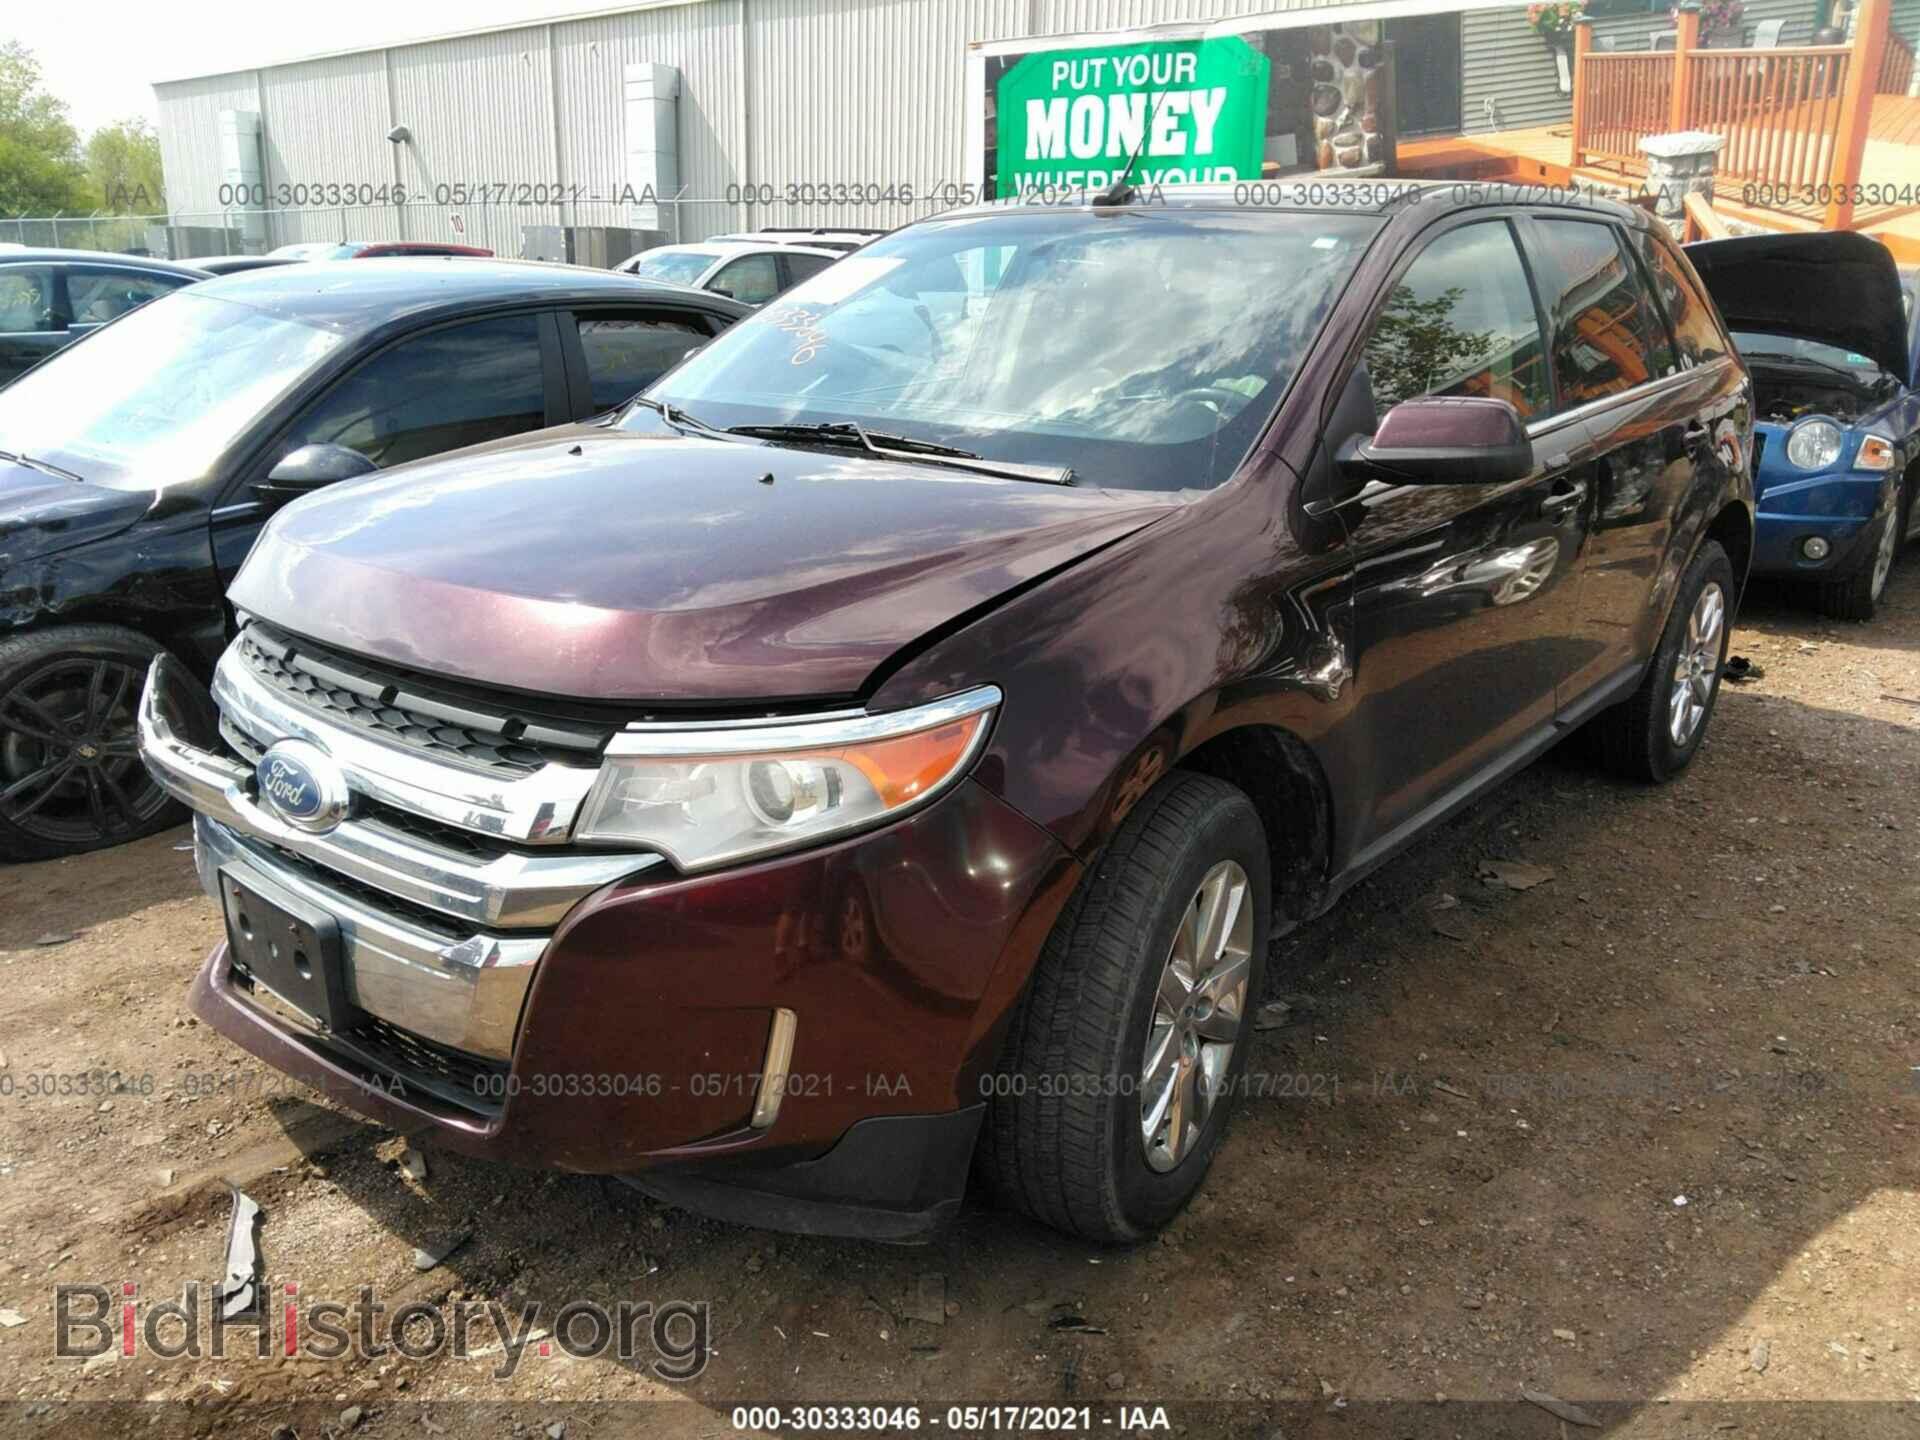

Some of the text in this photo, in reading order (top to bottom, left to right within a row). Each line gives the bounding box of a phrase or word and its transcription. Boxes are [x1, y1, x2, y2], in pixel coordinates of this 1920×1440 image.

[1052, 51, 1198, 91] PUT YOUR
[1025, 86, 1228, 161] MONEY
[264, 759, 308, 806] Ford
